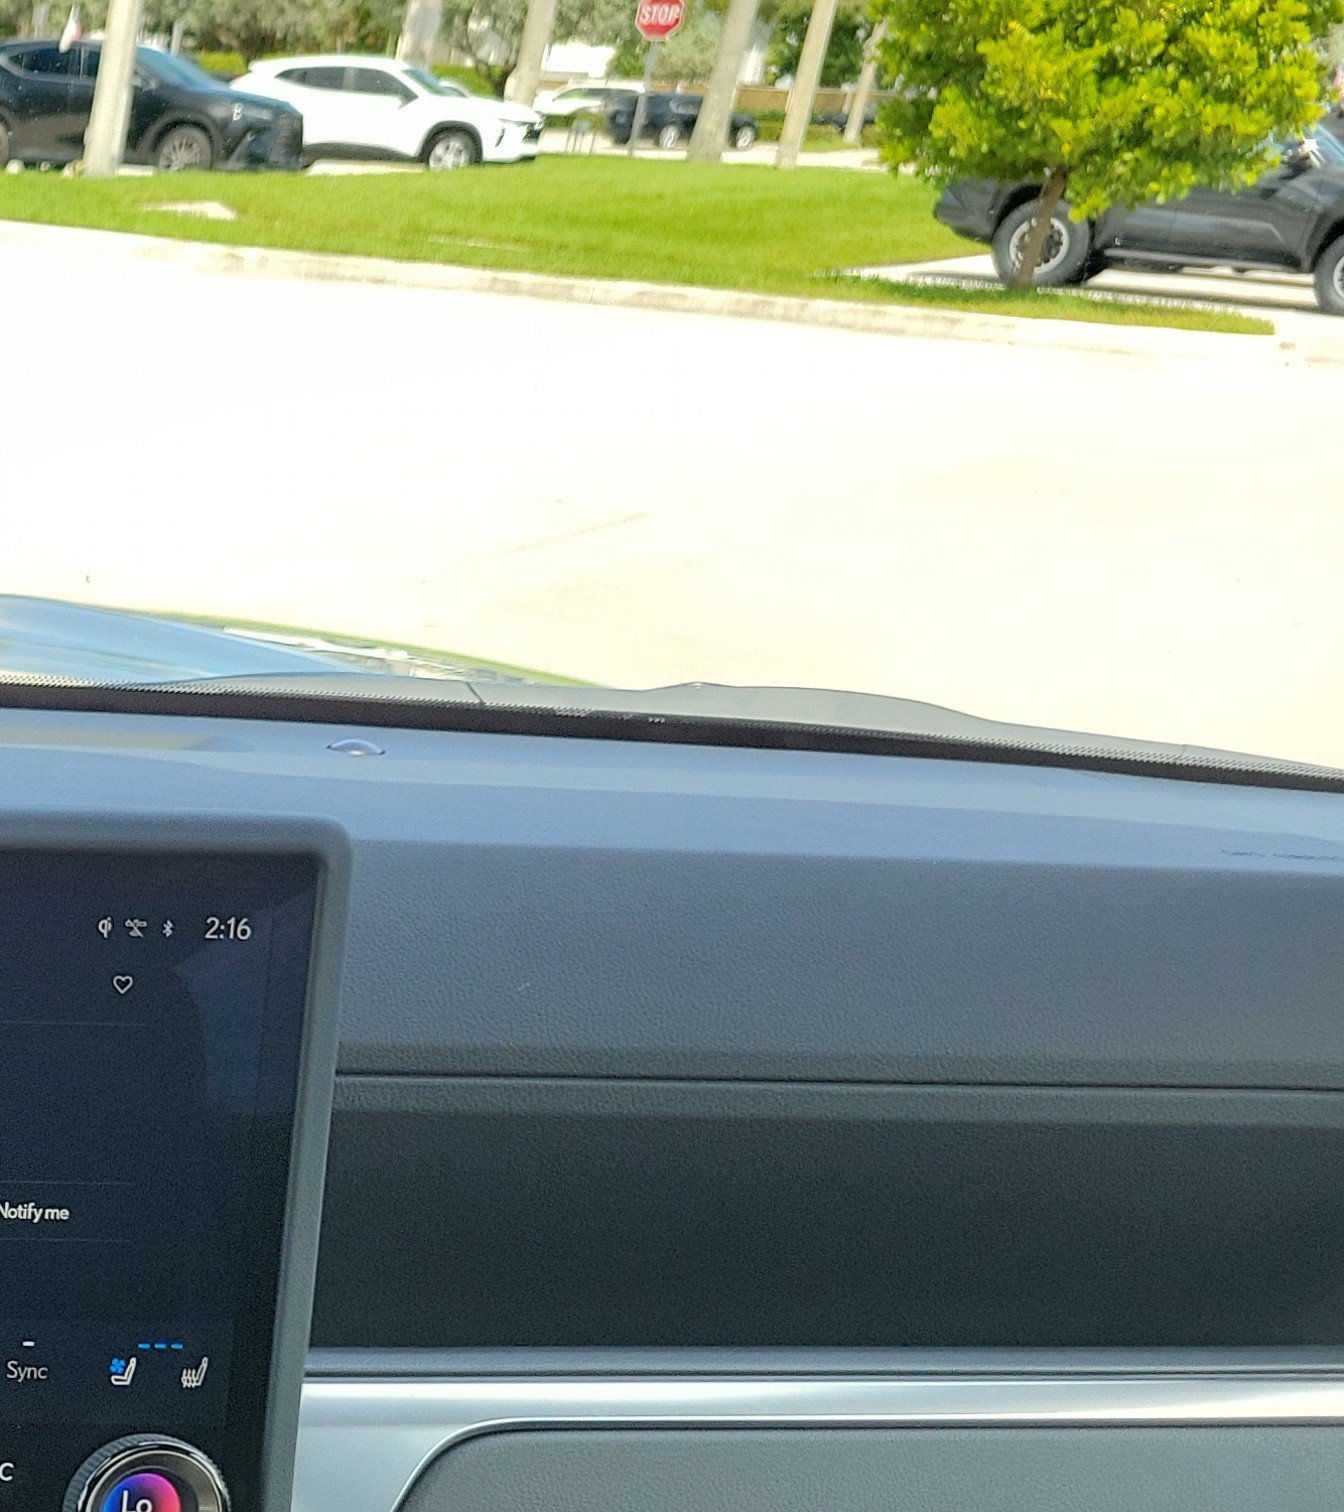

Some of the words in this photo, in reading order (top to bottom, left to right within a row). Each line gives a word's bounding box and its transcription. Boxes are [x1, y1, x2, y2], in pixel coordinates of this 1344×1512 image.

[640, 4, 680, 24] STOP
[205, 916, 251, 941] 2:16
[42, 1205, 70, 1221] me
[6, 1360, 48, 1381] Sync
